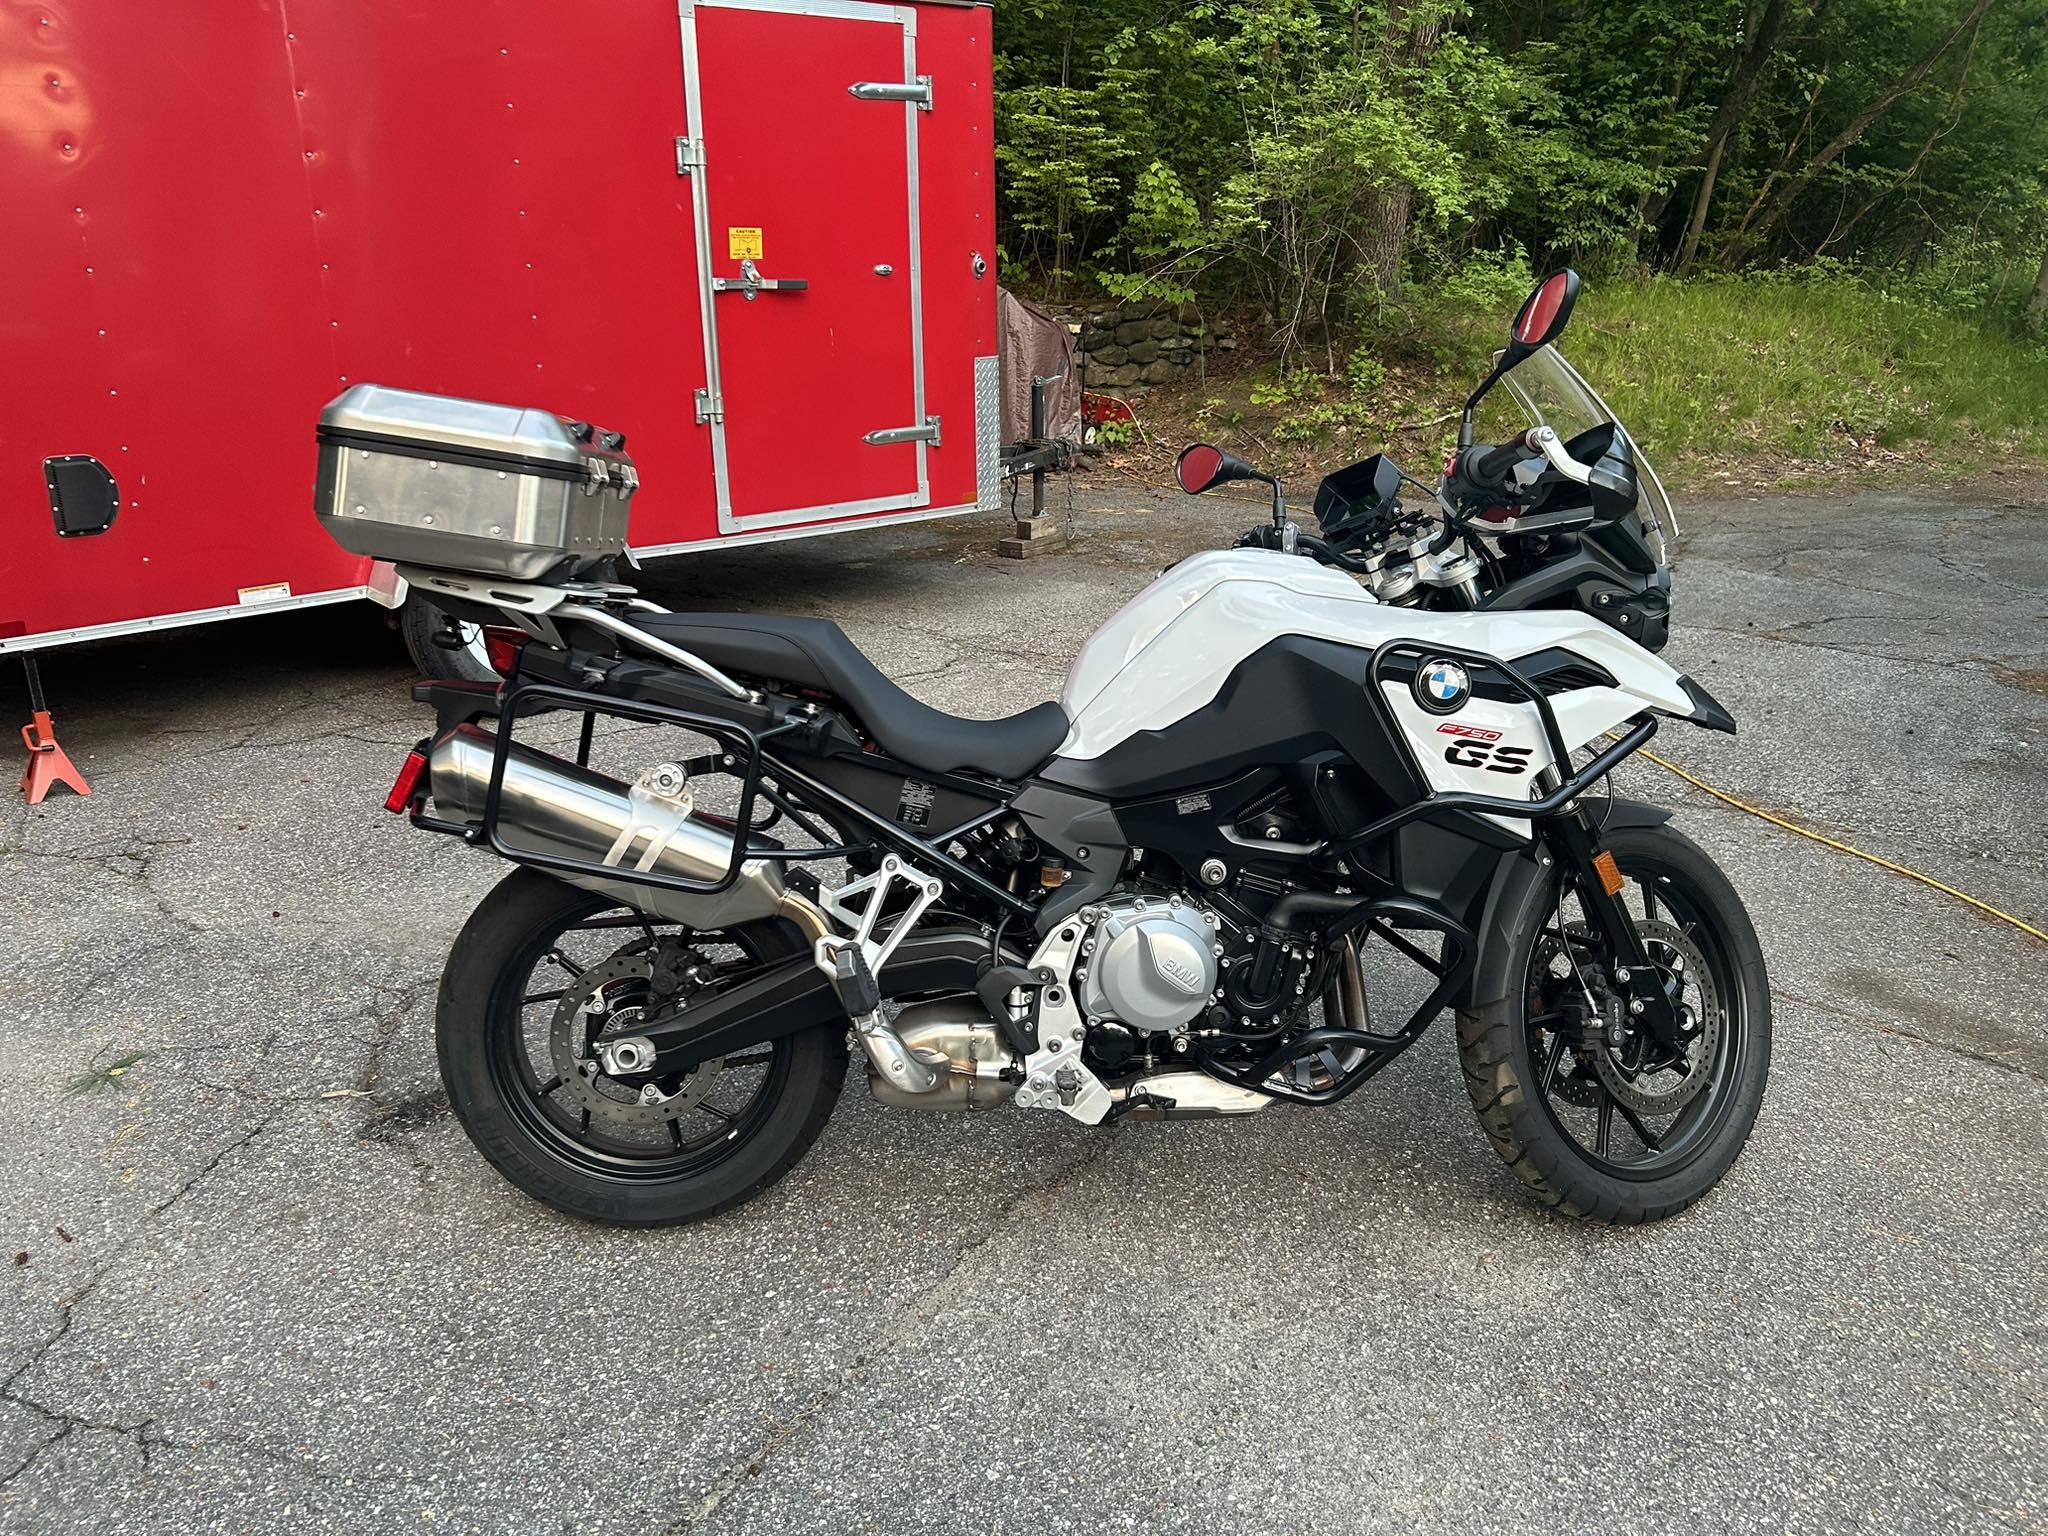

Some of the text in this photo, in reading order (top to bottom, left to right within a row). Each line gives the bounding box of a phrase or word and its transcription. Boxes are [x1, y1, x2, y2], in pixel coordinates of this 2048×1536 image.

[1438, 723, 1502, 741] F750
[1444, 740, 1533, 774] GS
[1162, 959, 1200, 987] BMW
